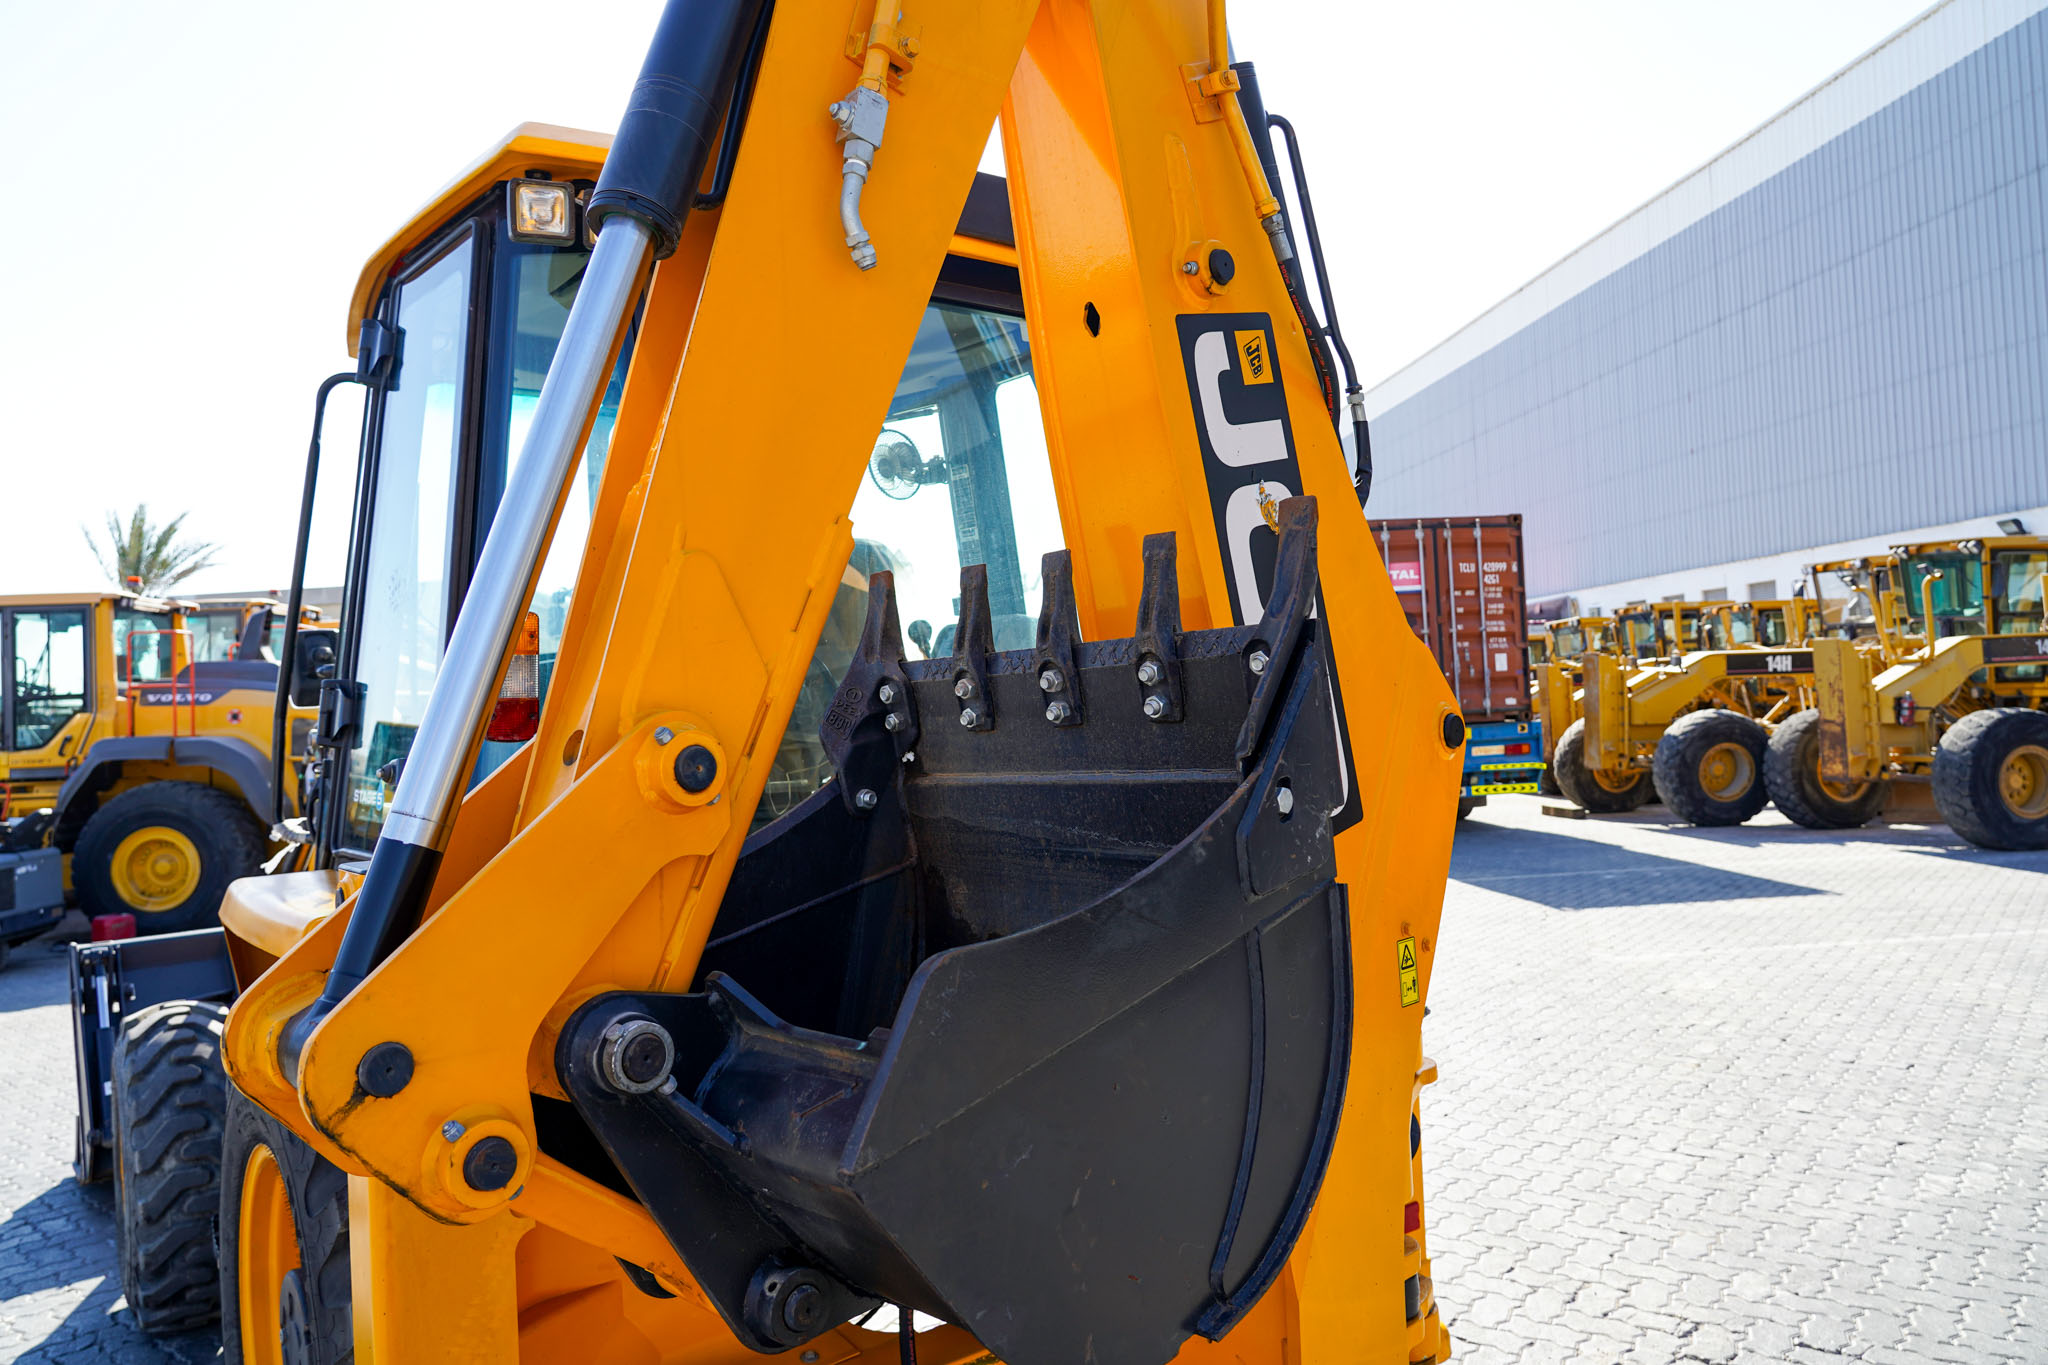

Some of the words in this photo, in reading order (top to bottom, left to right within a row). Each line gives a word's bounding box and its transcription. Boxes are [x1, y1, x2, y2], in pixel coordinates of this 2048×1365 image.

[1245, 343, 1262, 375] JCB
[1459, 562, 1476, 573] TCLU
[1389, 569, 1419, 580] TAL
[1765, 655, 1792, 672] 14H
[146, 692, 213, 703] VOLVO
